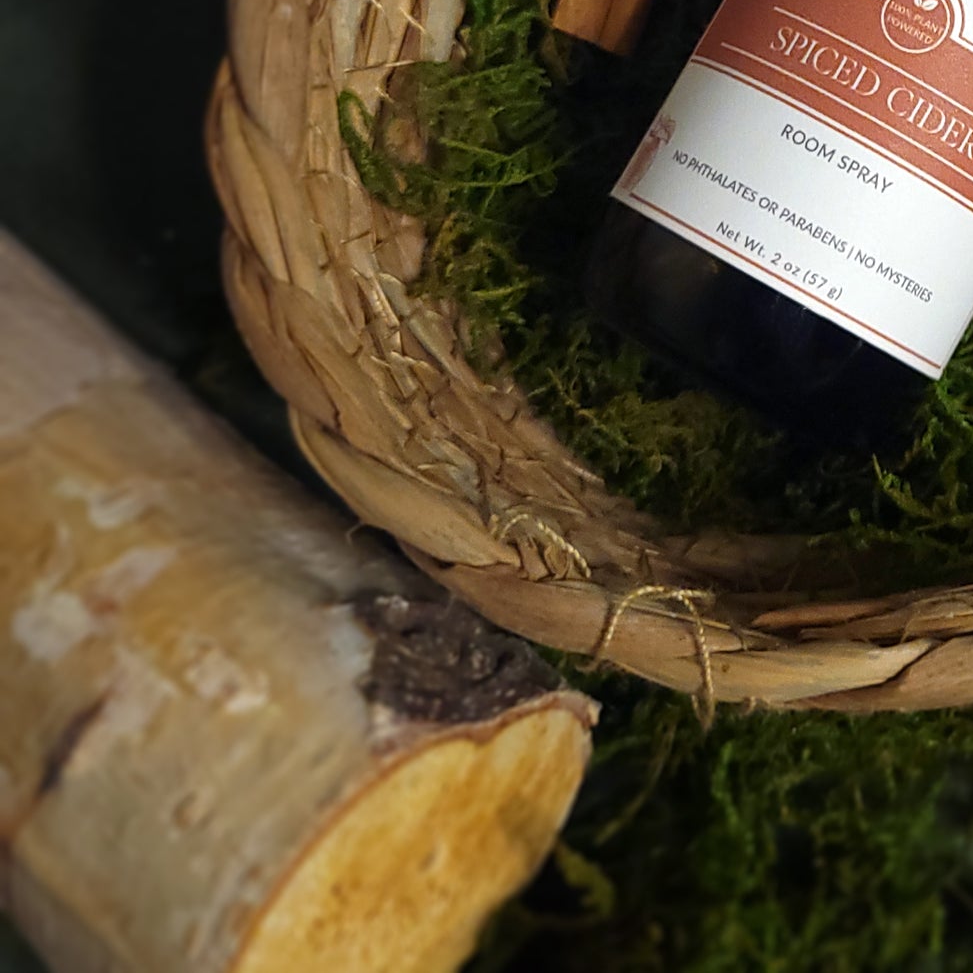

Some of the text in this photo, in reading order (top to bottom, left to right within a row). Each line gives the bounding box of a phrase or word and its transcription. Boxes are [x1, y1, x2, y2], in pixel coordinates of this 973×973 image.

[913, 14, 945, 36] PLANT
[769, 26, 881, 96] SPICED
[780, 123, 894, 194] ROOM SPRAY
[672, 149, 689, 165] NO
[686, 157, 758, 202] PHTHALATES
[758, 196, 780, 215] OR
[779, 207, 848, 253] PARABENS
[854, 249, 876, 269] NO
[876, 261, 934, 303] MYSTERIES
[715, 221, 844, 301] Net Wt. 2 oz (57 g)
